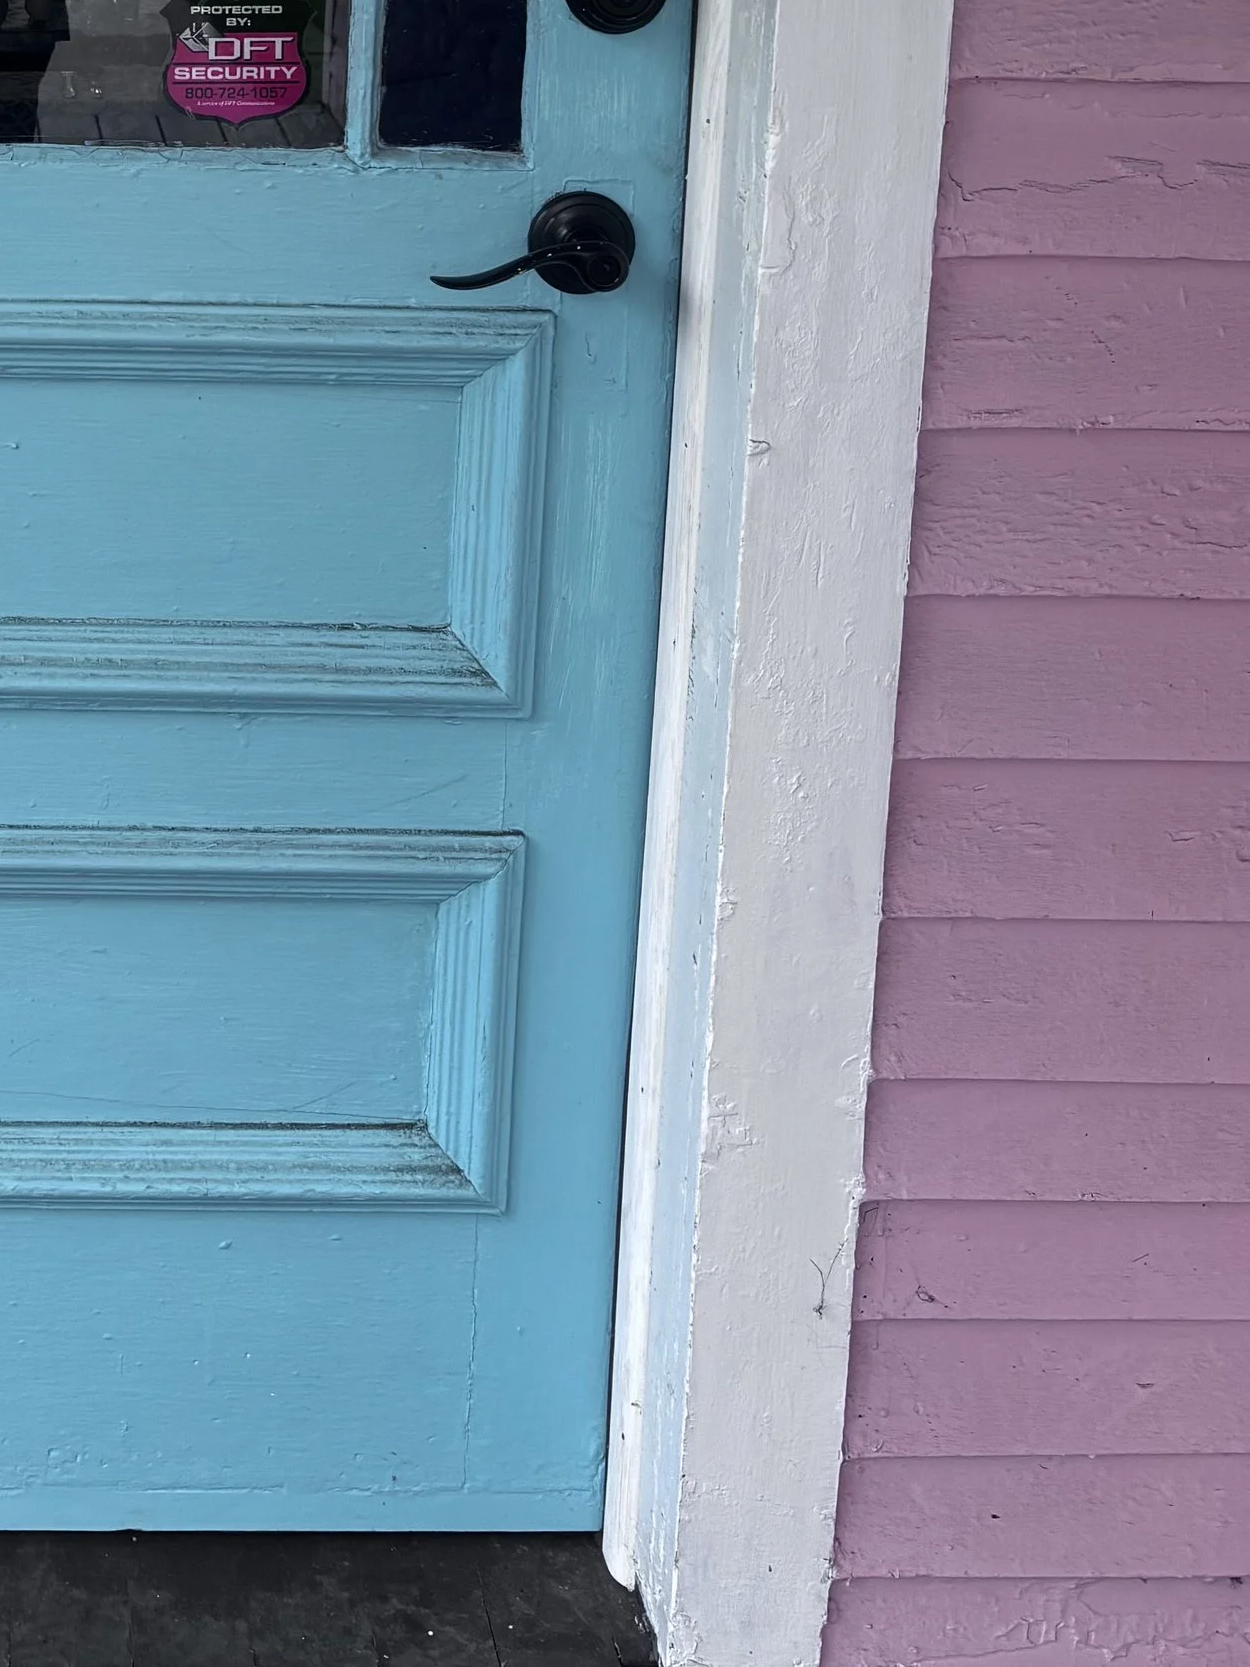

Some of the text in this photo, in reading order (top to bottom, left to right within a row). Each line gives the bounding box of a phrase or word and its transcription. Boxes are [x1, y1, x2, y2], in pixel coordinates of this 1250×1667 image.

[190, 5, 283, 14] PROTECTED
[226, 17, 251, 26] BY:
[208, 36, 294, 60] DFT
[174, 66, 298, 80] SECURITY
[185, 87, 287, 99] 800-724-1057
